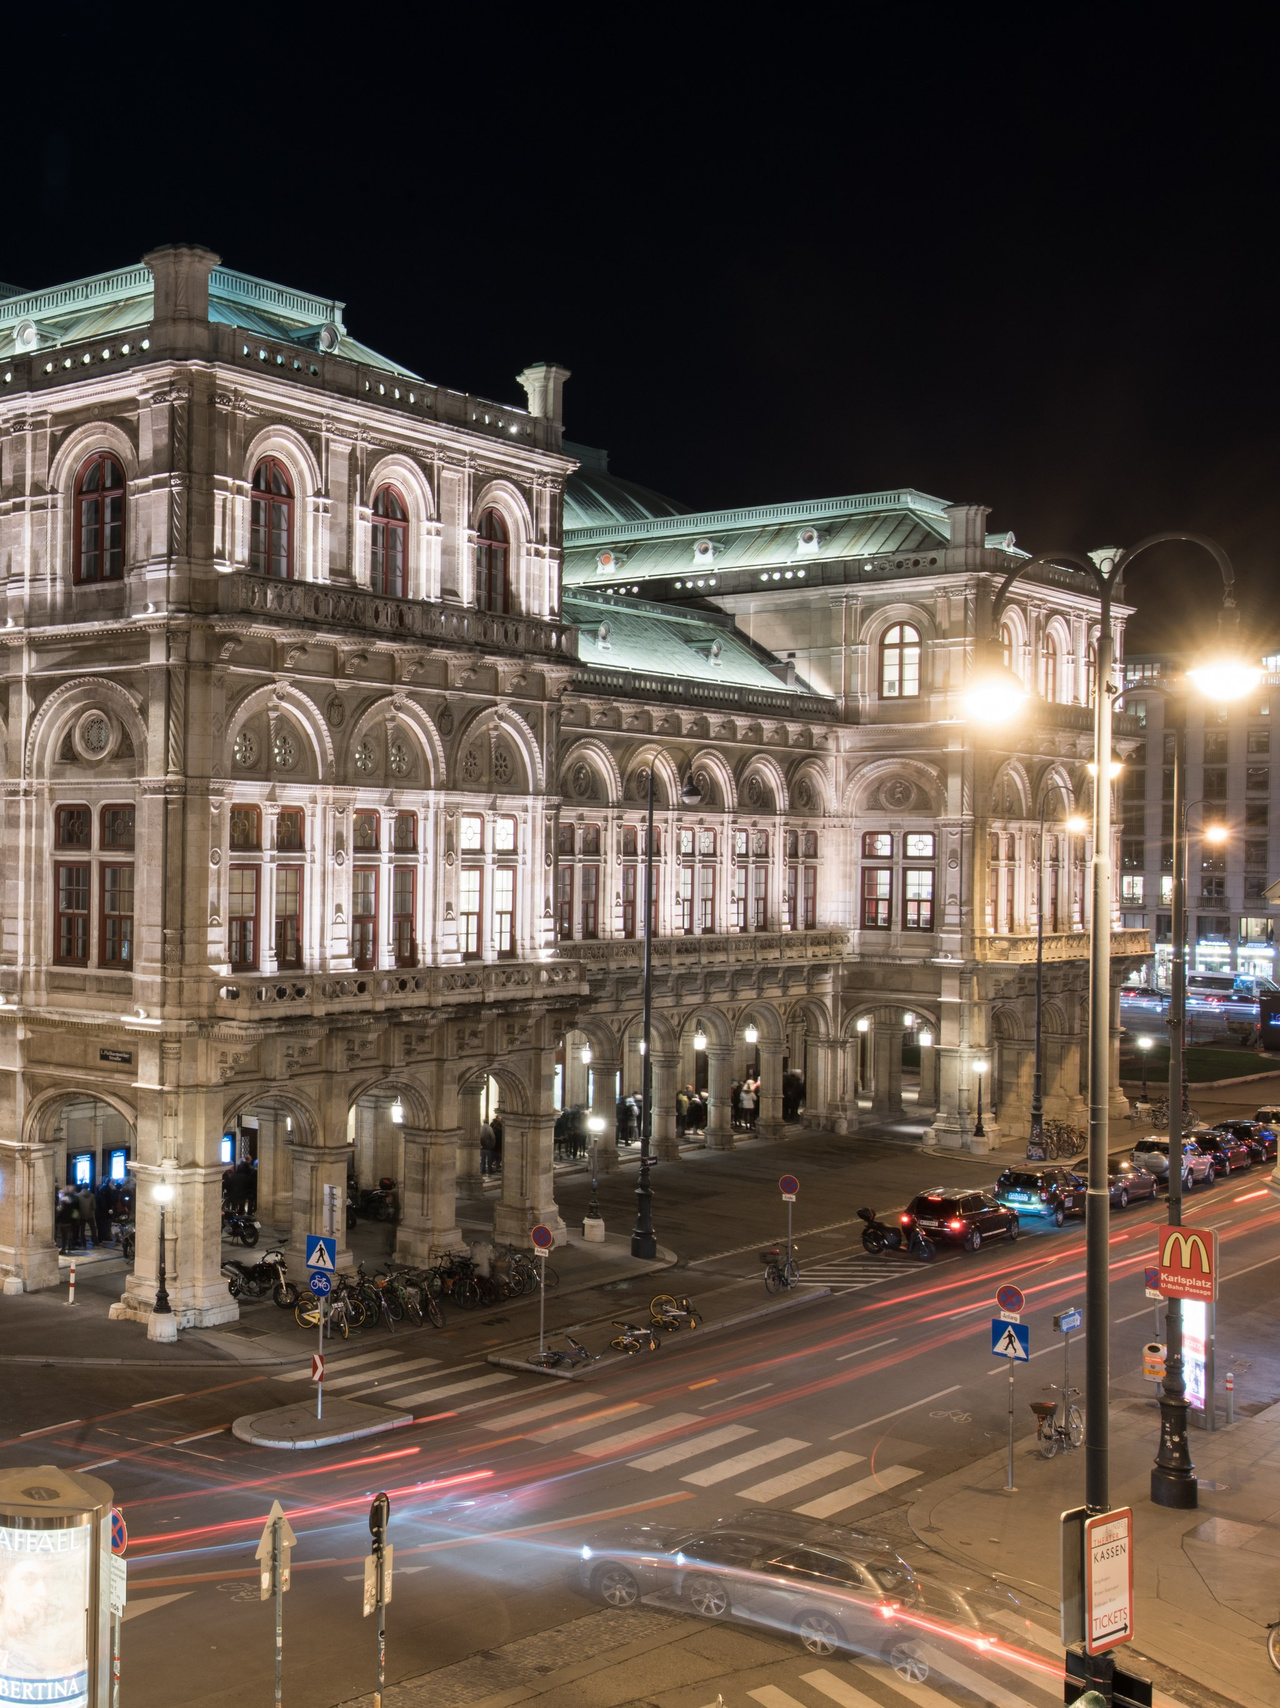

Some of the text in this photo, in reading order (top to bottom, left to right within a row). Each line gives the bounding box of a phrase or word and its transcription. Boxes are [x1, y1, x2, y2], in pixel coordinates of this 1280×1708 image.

[1160, 1273, 1212, 1289] Karlsplatz
[1160, 1282, 1212, 1296] U-Bahn Passage
[1002, 1312, 1019, 1322] Anfang
[1093, 1533, 1119, 1546] THEATER
[1093, 1543, 1127, 1564] KASSEN
[1093, 1607, 1128, 1631] TICKETS
